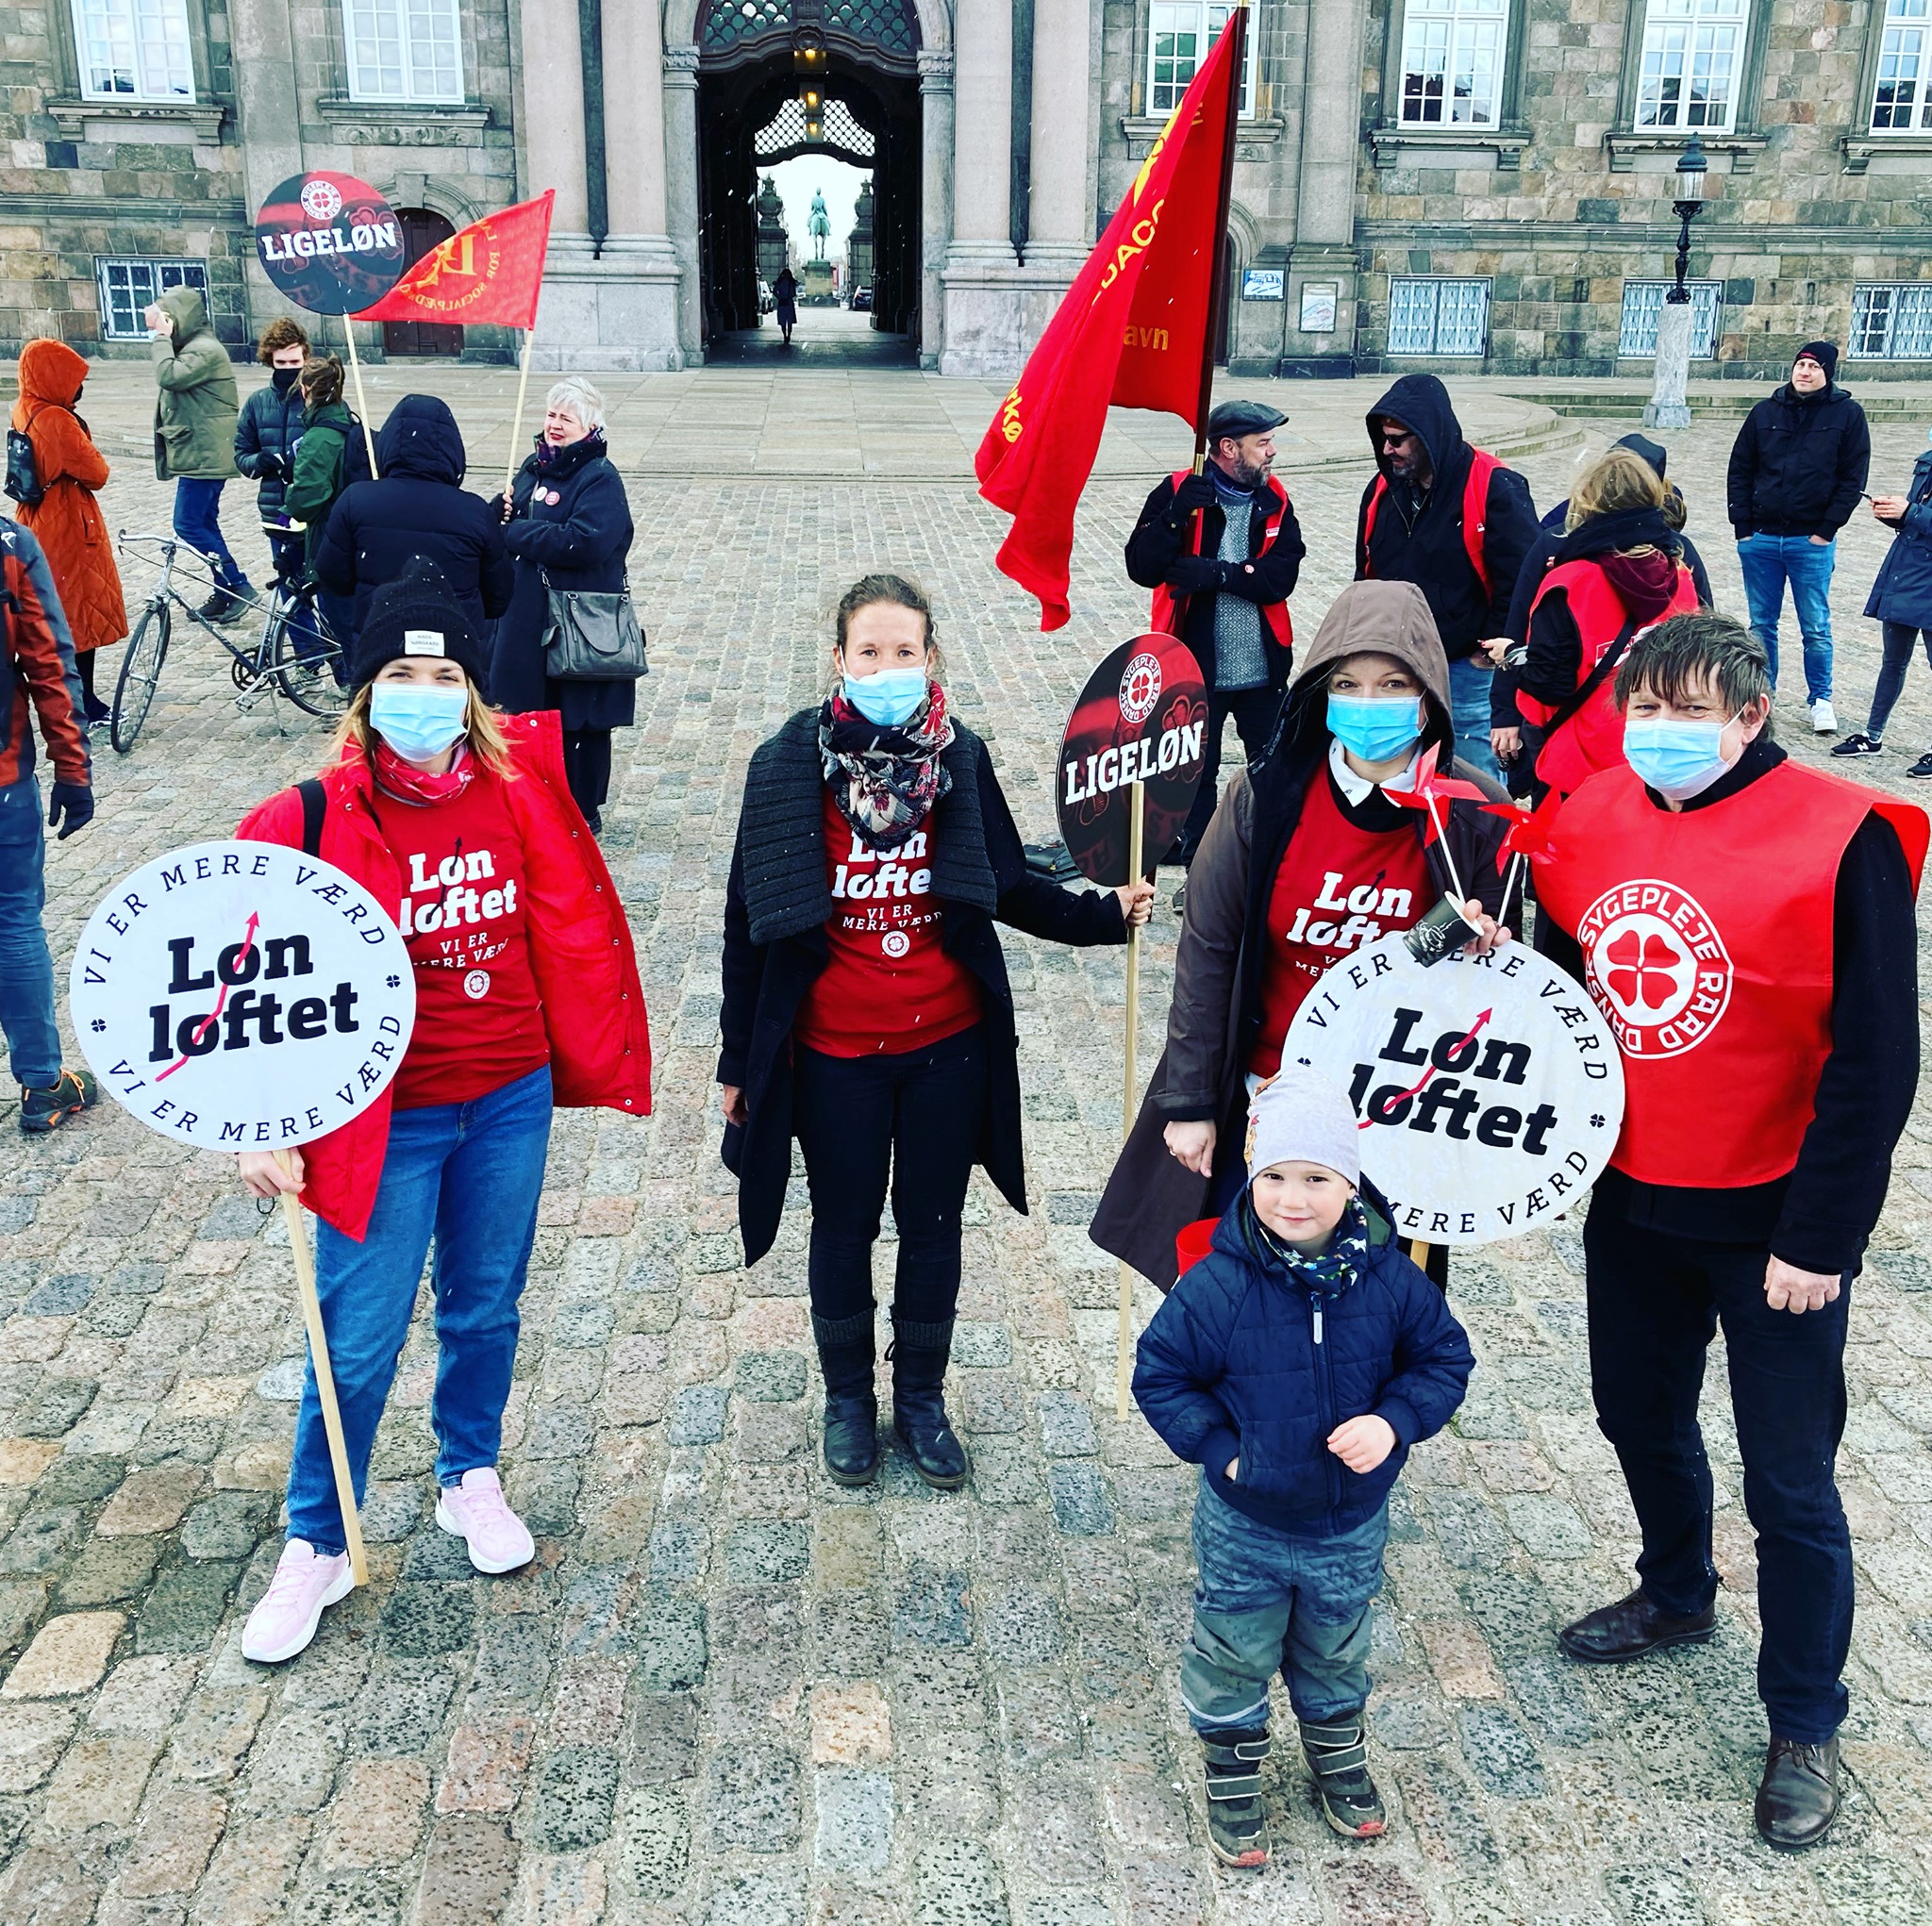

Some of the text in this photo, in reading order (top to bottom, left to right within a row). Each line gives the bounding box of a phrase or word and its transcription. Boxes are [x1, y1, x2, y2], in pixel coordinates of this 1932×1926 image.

[261, 223, 396, 260] LIGELØN
[1065, 721, 1204, 805] LIGELØN
[84, 855, 385, 986] VI ER MERE VÆRD
[440, 932, 488, 954] VI ER
[842, 916, 889, 931] MERE
[867, 905, 912, 920] VI ER
[1307, 947, 1607, 1080] VI ER ERE VÆRD
[108, 1015, 401, 1141] VI ER MERE VÆRD
[1497, 1151, 1588, 1225] VÆRD
